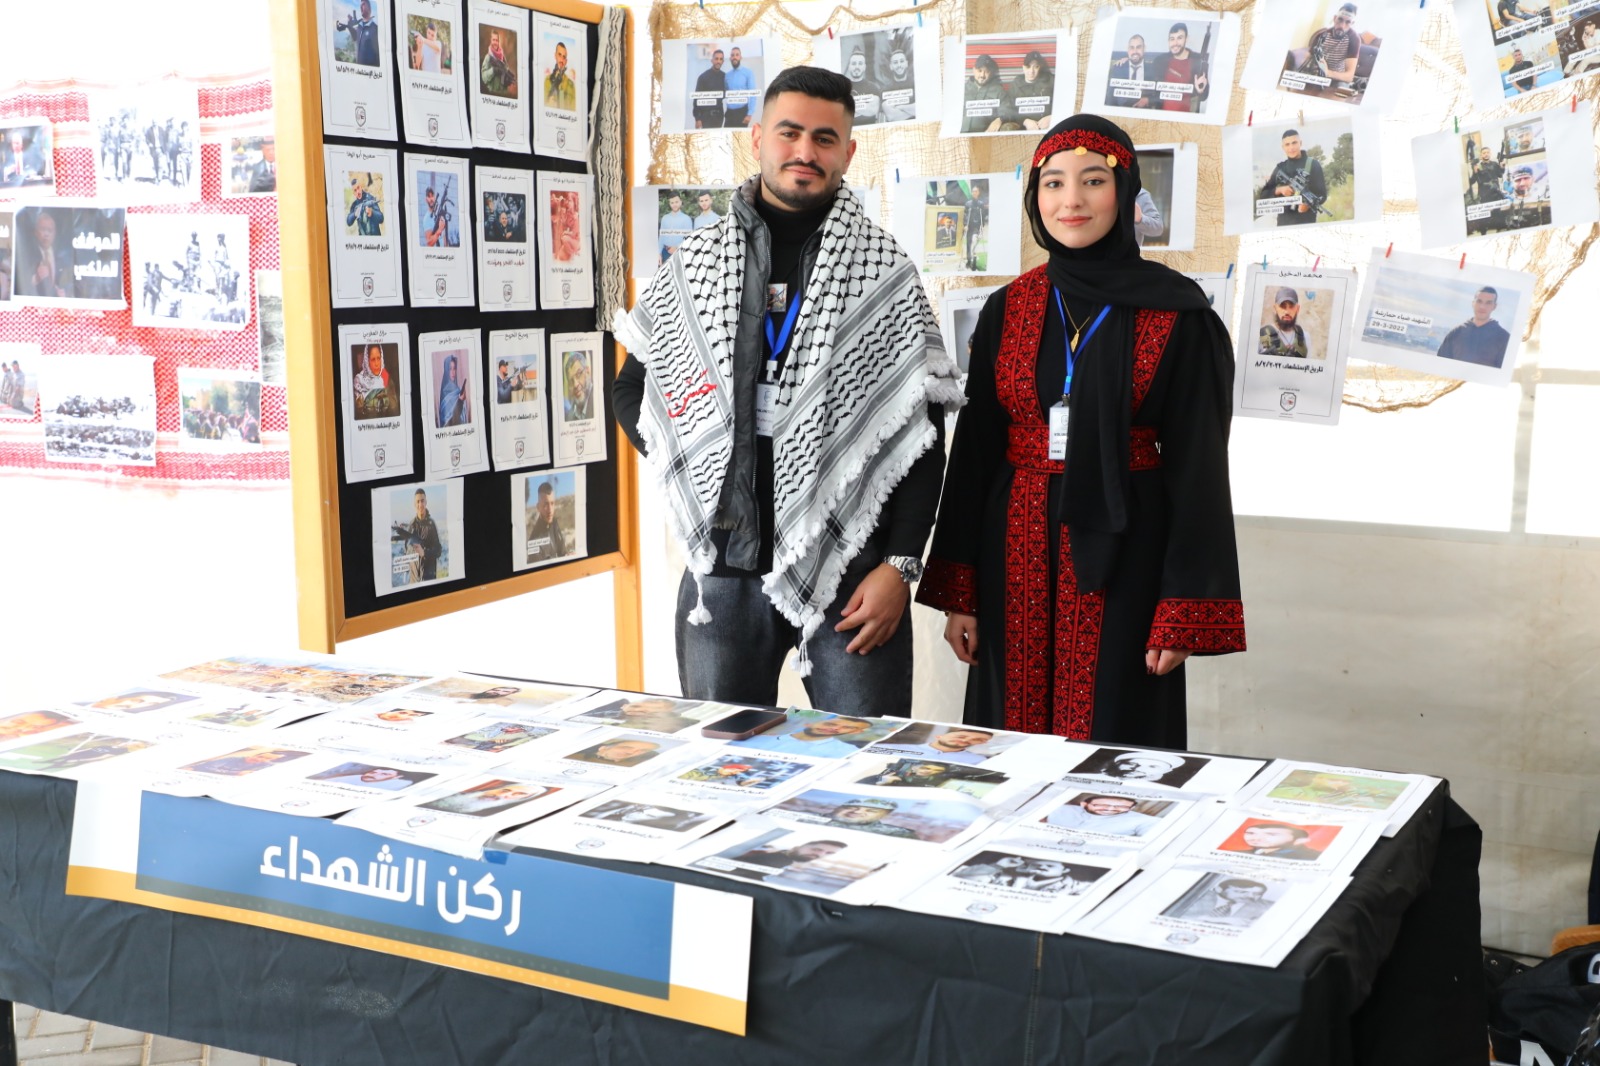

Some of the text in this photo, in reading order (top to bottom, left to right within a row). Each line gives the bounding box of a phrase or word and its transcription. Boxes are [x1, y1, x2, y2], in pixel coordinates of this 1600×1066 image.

[72, 231, 121, 253] الموقف
[73, 260, 119, 281] الملكي
[1310, 366, 1324, 374] تاريخ
[259, 835, 522, 936] ركن الشهداء
